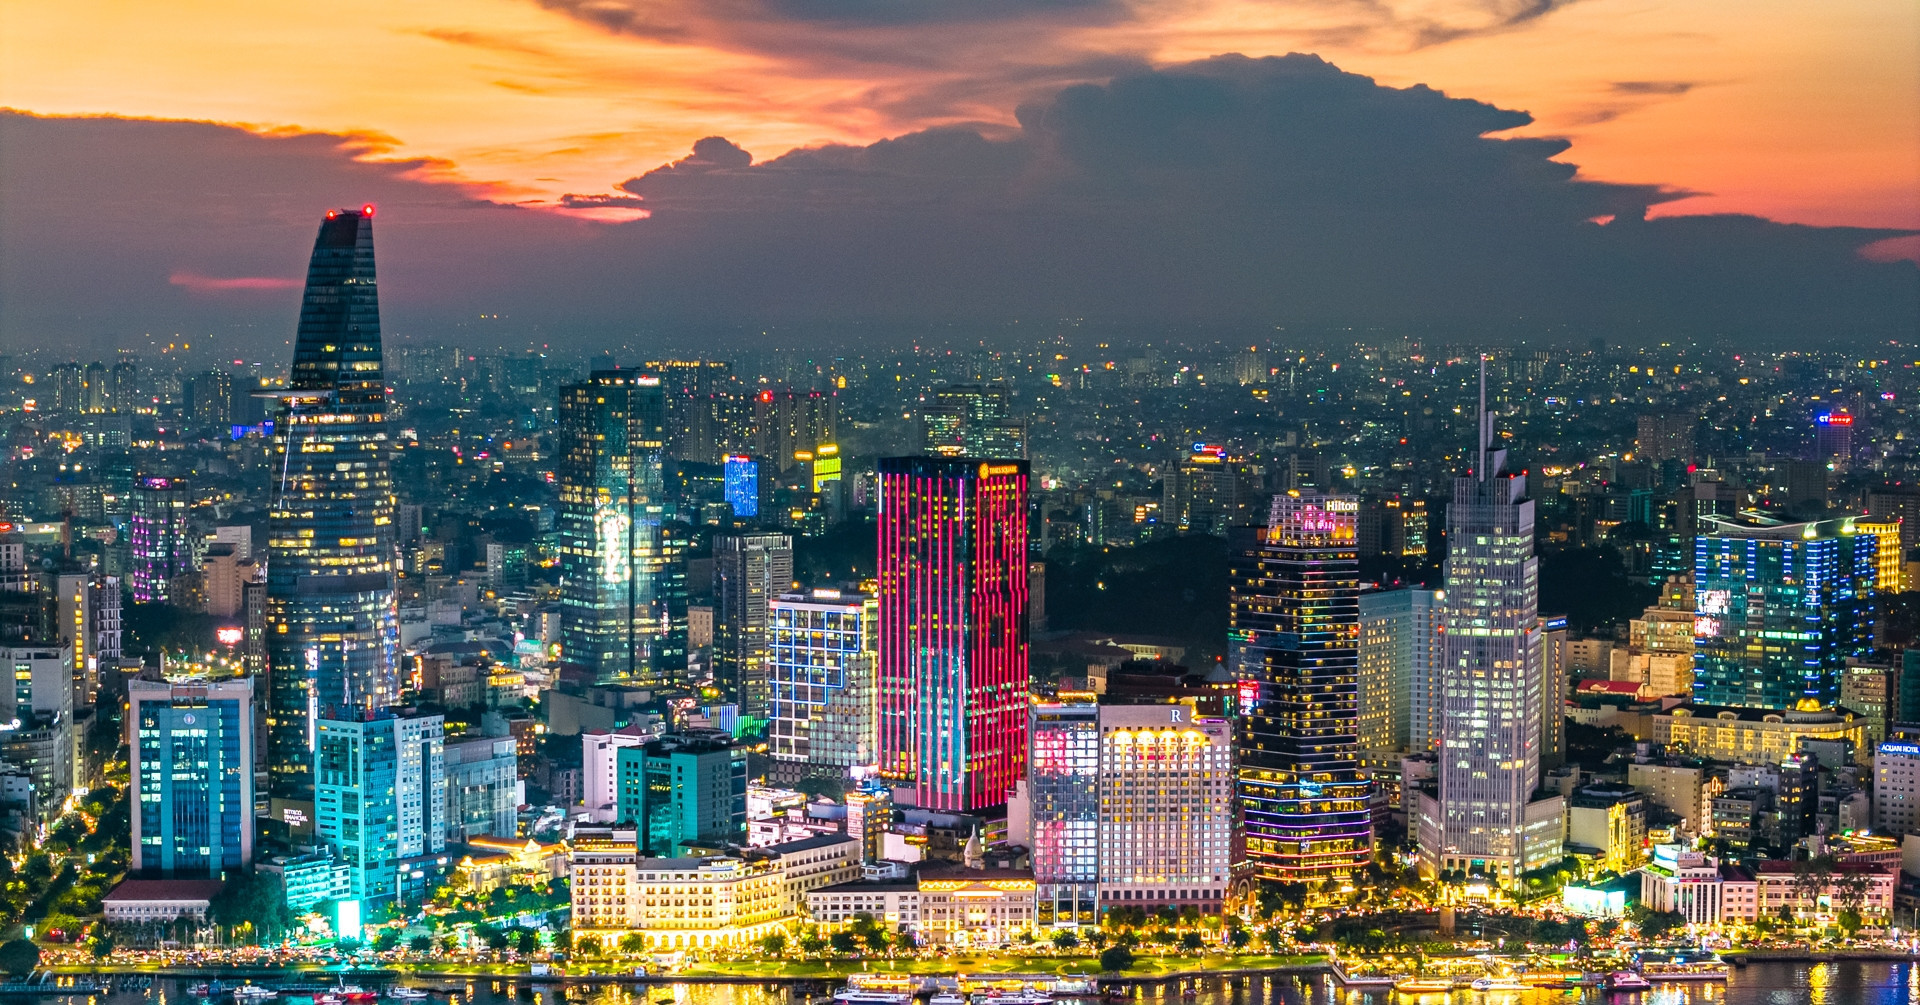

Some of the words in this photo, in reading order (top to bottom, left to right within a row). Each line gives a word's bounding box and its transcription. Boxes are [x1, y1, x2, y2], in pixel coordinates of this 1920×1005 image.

[989, 467, 1002, 475] TIMES
[1002, 465, 1017, 474] SQUARE
[1326, 500, 1358, 511] Hilton
[1171, 709, 1184, 723] R
[1903, 745, 1919, 753] HOTEL
[283, 814, 308, 822] FINANCIAL
